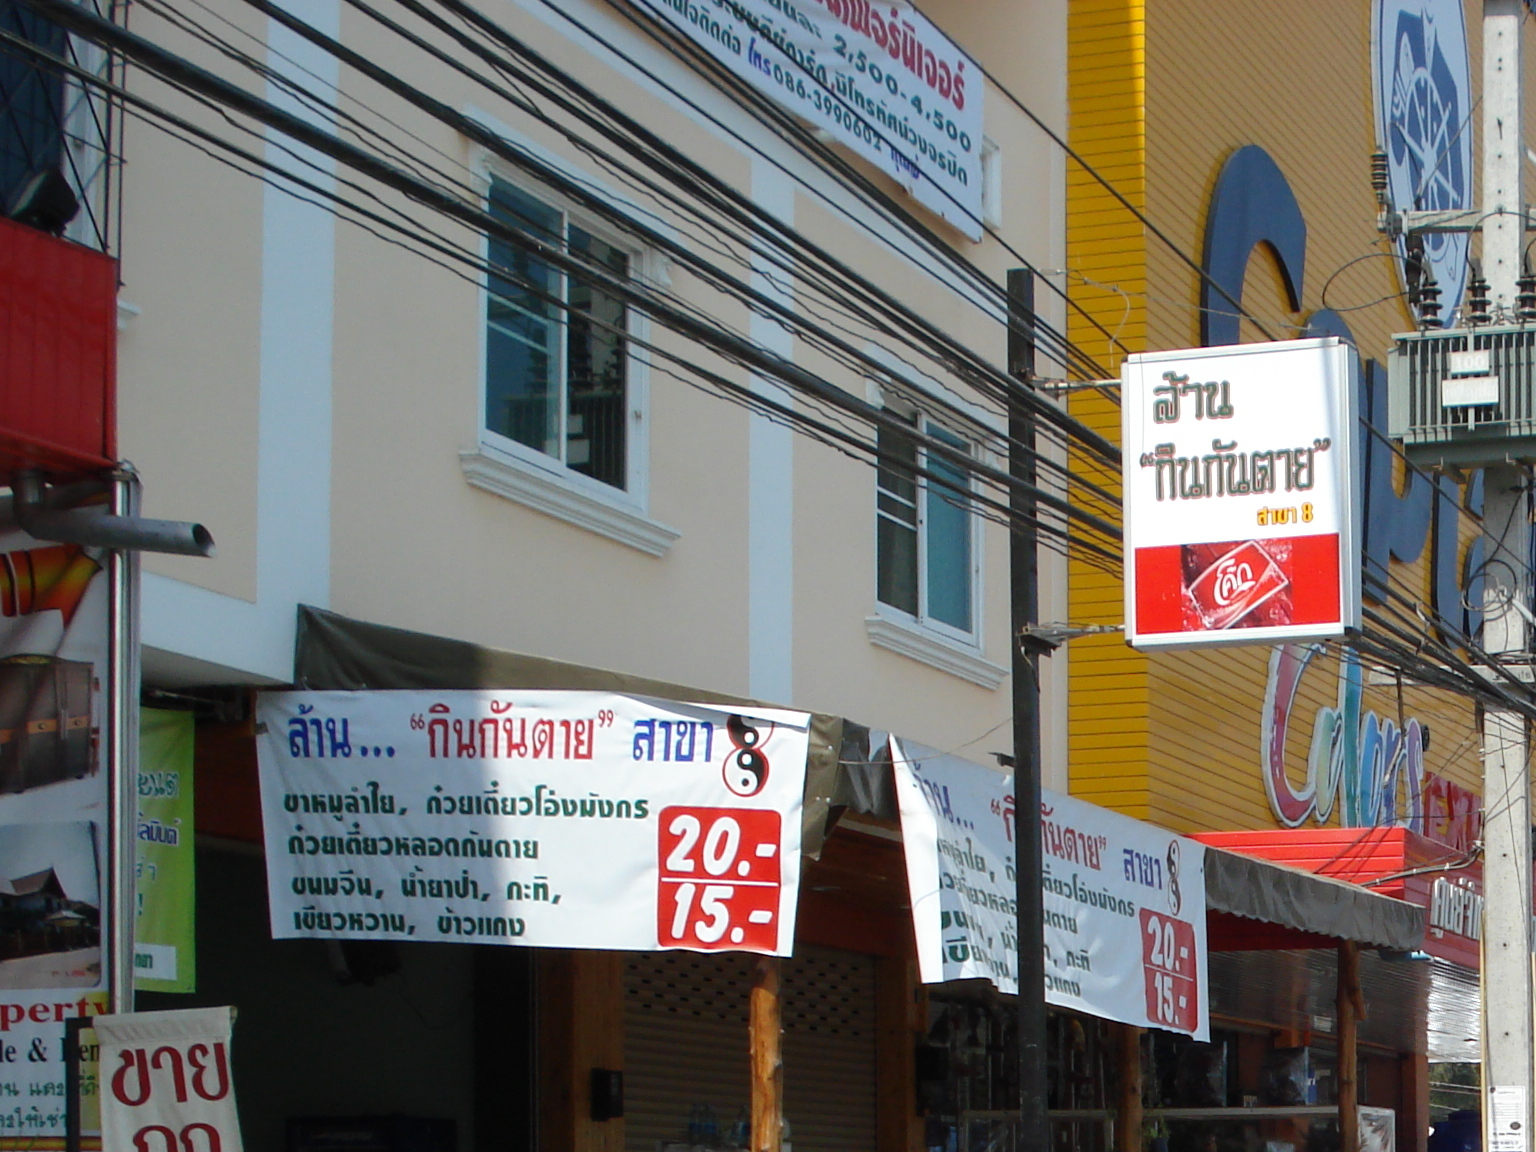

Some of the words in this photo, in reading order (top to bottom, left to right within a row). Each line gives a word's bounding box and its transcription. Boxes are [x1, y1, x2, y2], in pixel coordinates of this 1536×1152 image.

[1153, 371, 1234, 424] ล้าน
[1257, 507, 1297, 526] สาขา
[1301, 502, 1314, 524] 8
[633, 718, 714, 763] สาขา
[1123, 848, 1163, 891] สาขา
[437, 906, 526, 938] ข้าวแกง
[27, 1037, 47, 1063] &
[110, 1041, 230, 1107] ขาย
